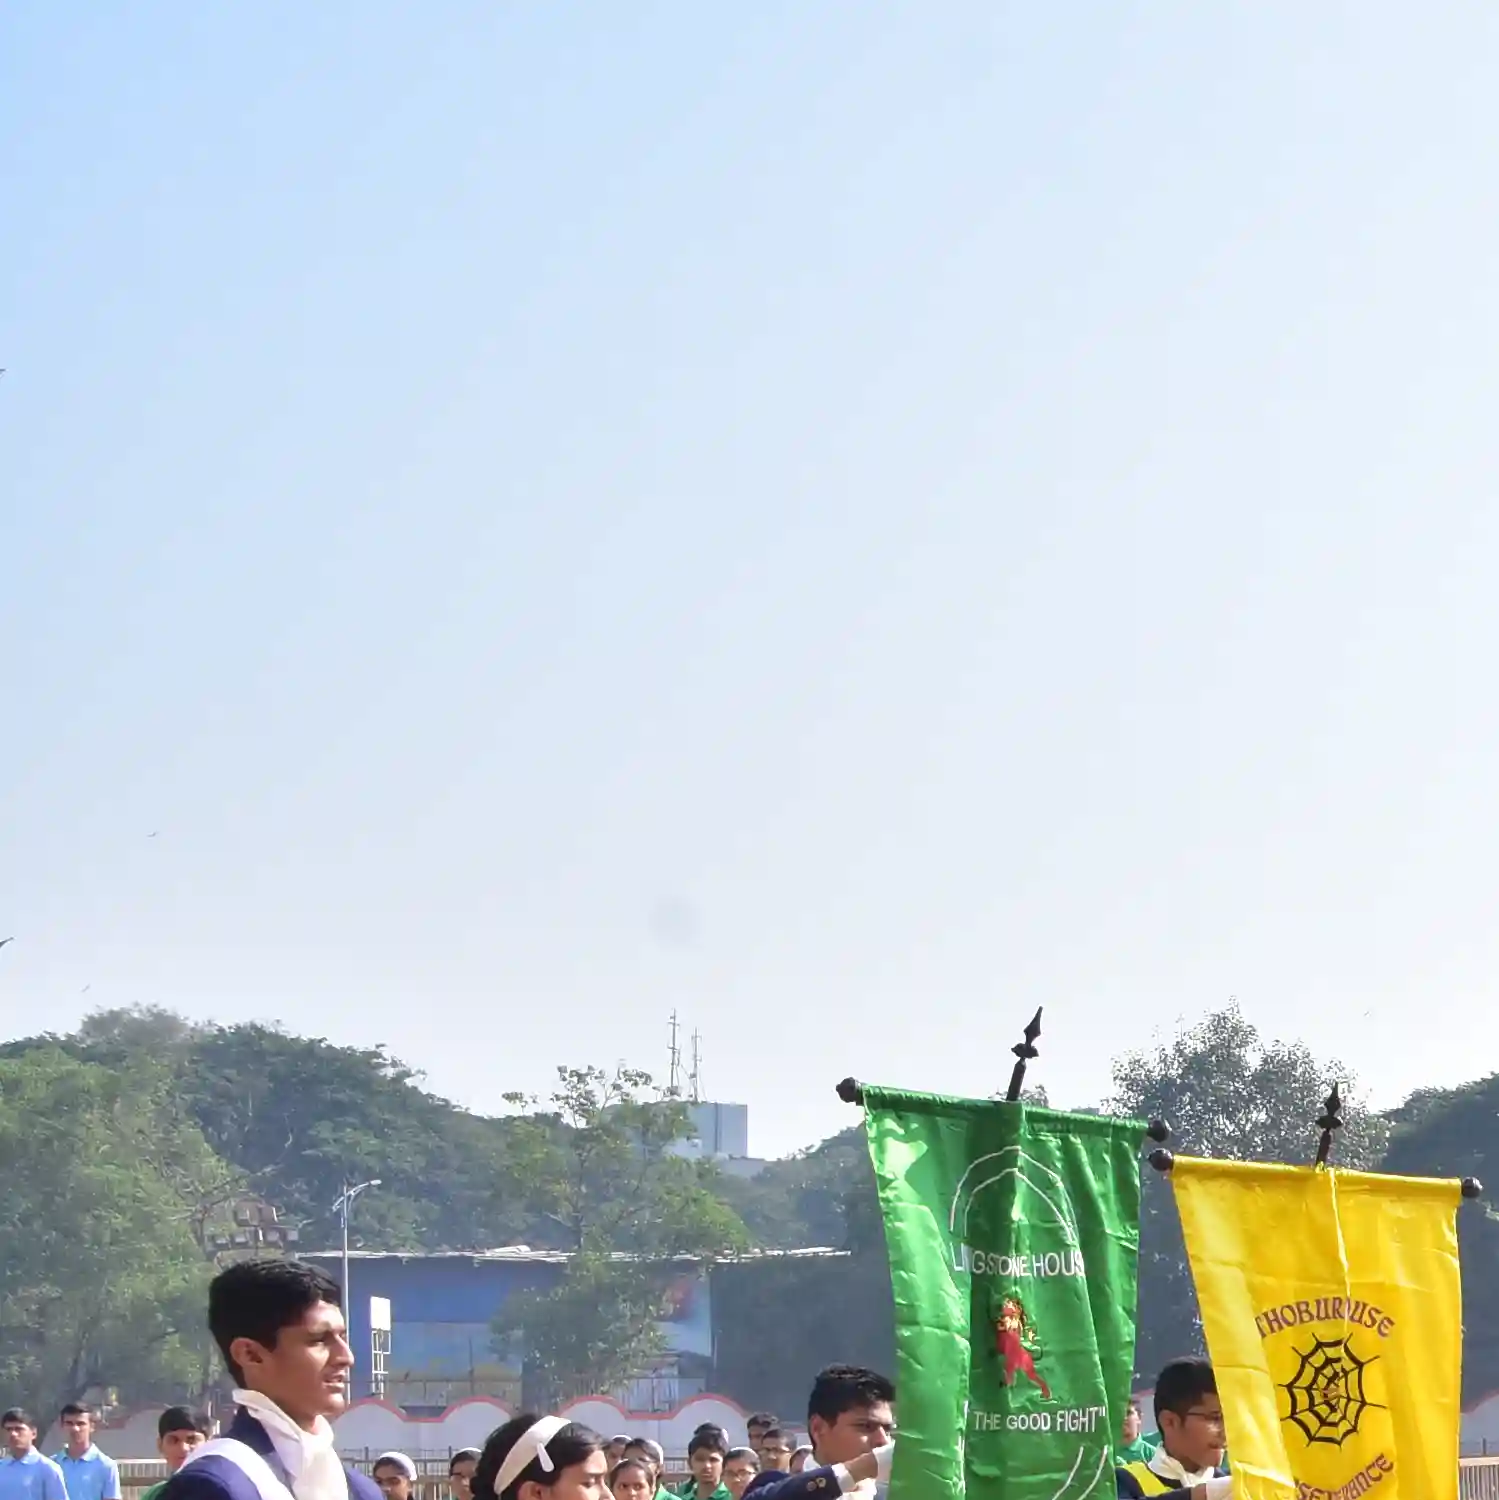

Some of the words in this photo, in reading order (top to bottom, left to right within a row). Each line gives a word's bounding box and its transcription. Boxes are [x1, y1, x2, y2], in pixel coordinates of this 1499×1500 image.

[1032, 1250, 1085, 1279] HOUS
[973, 1411, 1001, 1431] THE
[1006, 1412, 1051, 1431] GOOD
